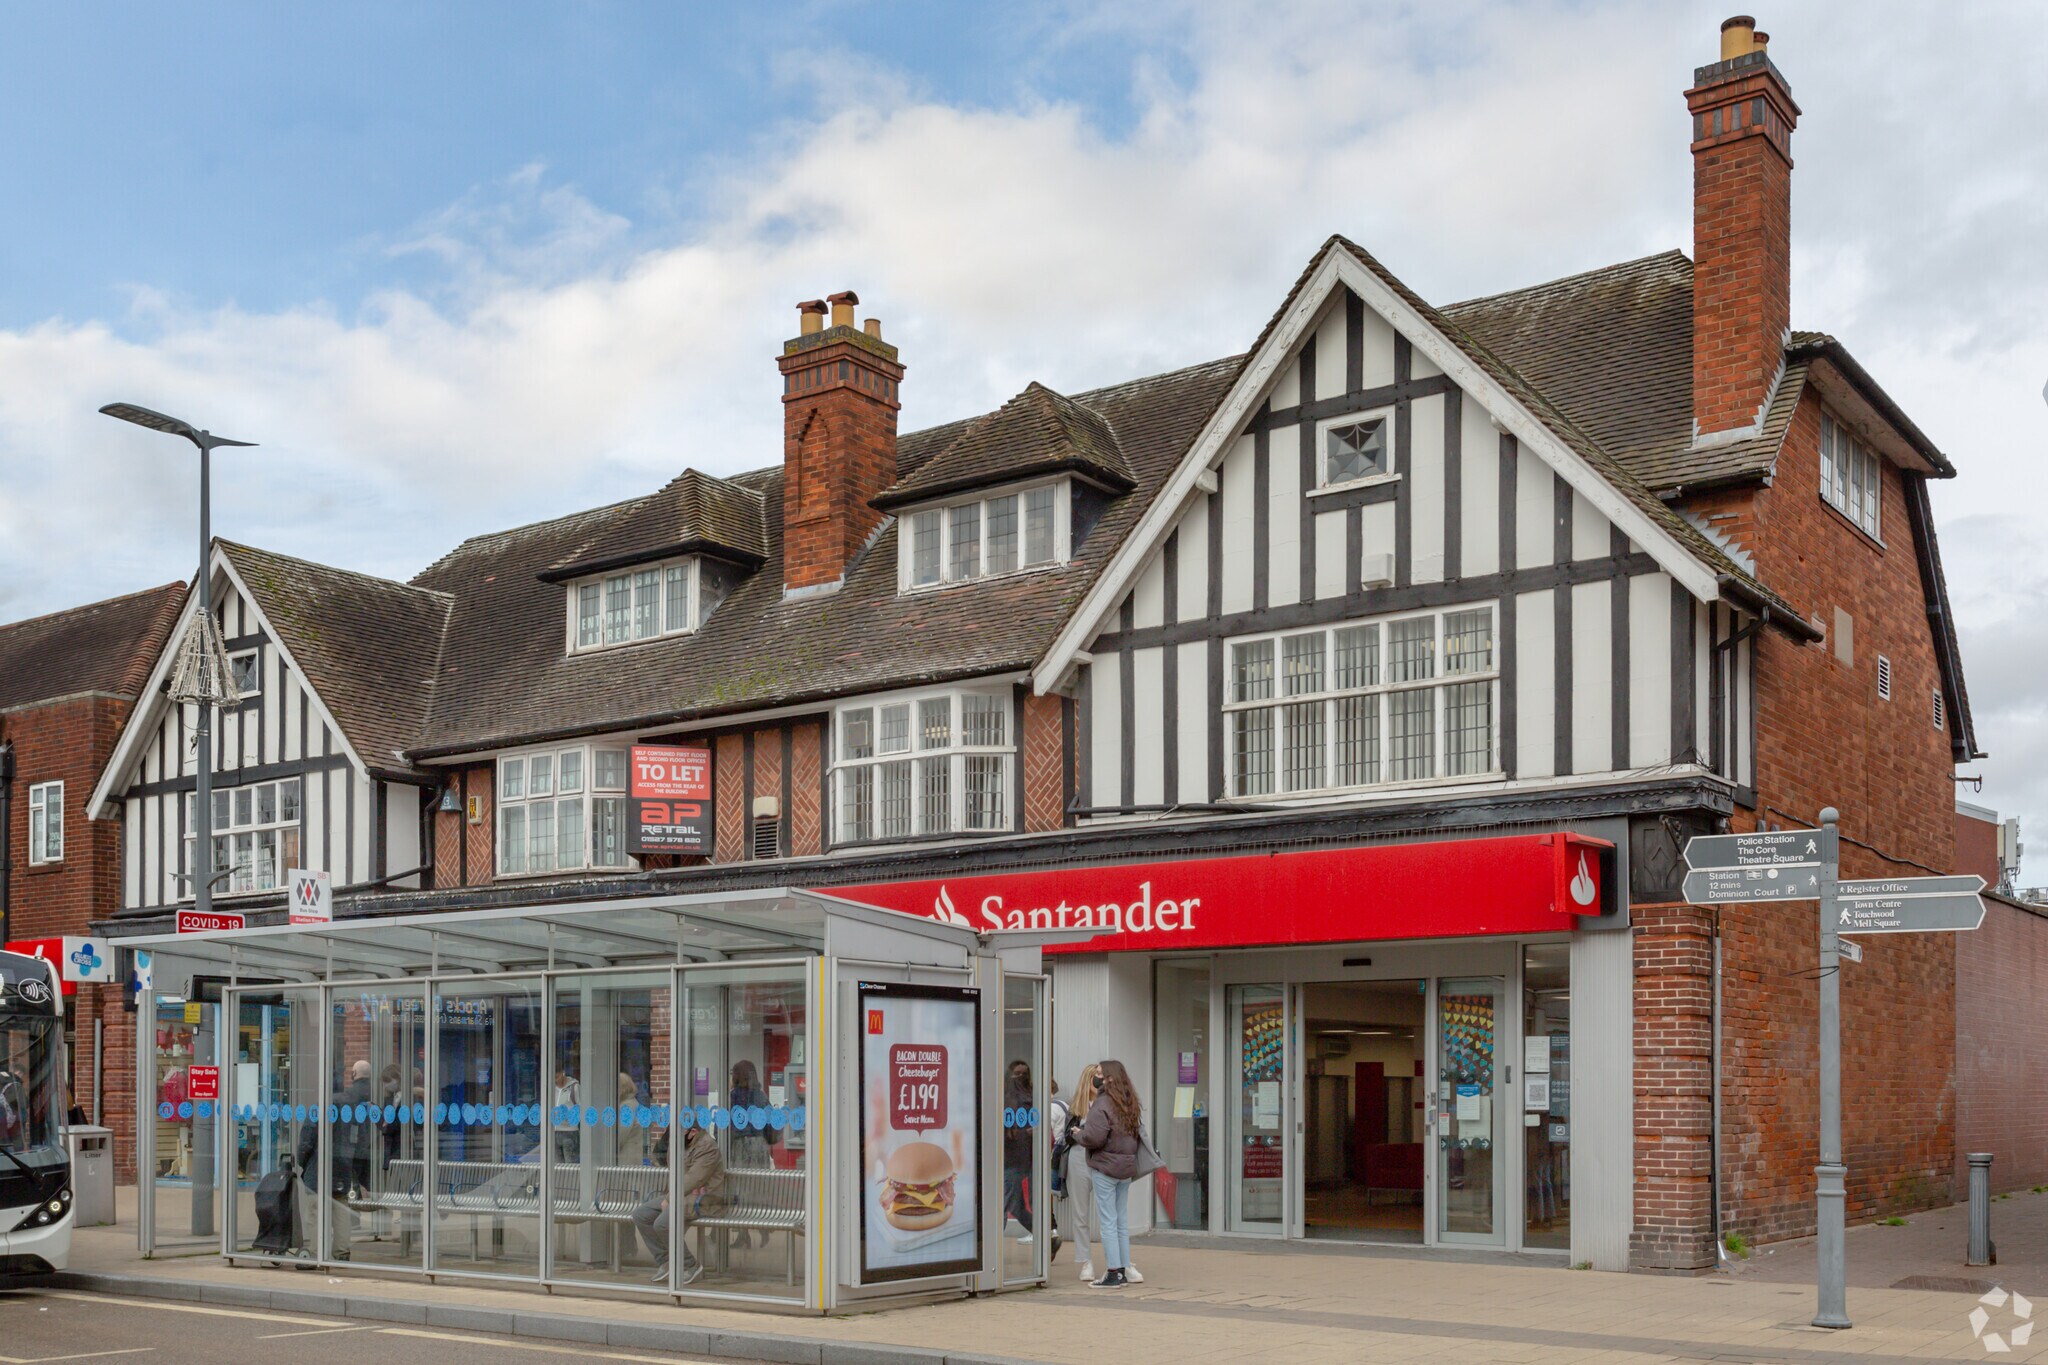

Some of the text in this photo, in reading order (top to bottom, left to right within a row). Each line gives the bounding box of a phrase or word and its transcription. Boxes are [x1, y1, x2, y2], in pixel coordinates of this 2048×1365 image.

[636, 567, 681, 586] SHACK
[581, 604, 650, 631] ENTRANCE
[607, 624, 642, 642] REAR
[638, 763, 704, 782] TO LET
[1737, 836, 1795, 846] Police Station
[1738, 846, 1777, 855] The Core
[1738, 854, 1804, 864] Theatre Square
[317, 872, 326, 880] SB
[1709, 871, 1740, 880] Station
[1709, 890, 1749, 898] Dominion
[1754, 888, 1779, 896] Court
[1846, 883, 1908, 894] Register Office
[980, 881, 1200, 934] Santander
[1853, 900, 1901, 909] Town Centre
[1853, 909, 1894, 919] Touchwood
[182, 916, 220, 929] COVID
[228, 919, 240, 930] 19
[1853, 919, 1901, 928] Mell Square
[74, 957, 91, 966] CROSS
[896, 1050, 942, 1062] BACON DOUBLE
[191, 1068, 217, 1076] Stay Safe
[898, 1064, 940, 1082] Cheeseburger
[898, 1083, 939, 1111] £1.99
